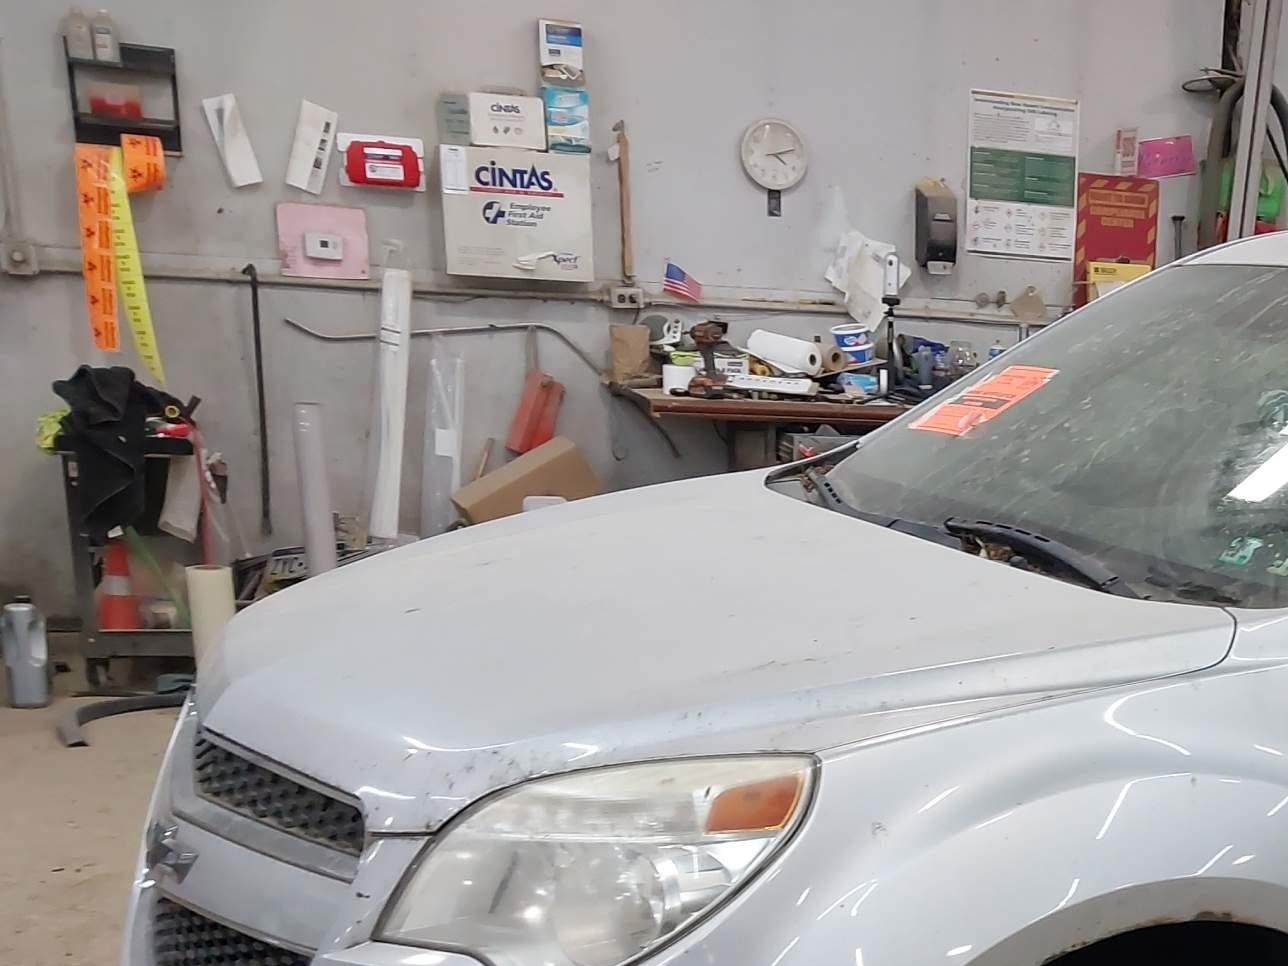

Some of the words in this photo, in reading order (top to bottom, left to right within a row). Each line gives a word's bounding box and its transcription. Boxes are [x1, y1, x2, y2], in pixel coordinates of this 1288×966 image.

[510, 203, 551, 212] Employee
[507, 211, 527, 219] First
[529, 211, 544, 219] Aid
[506, 219, 538, 227] Station
